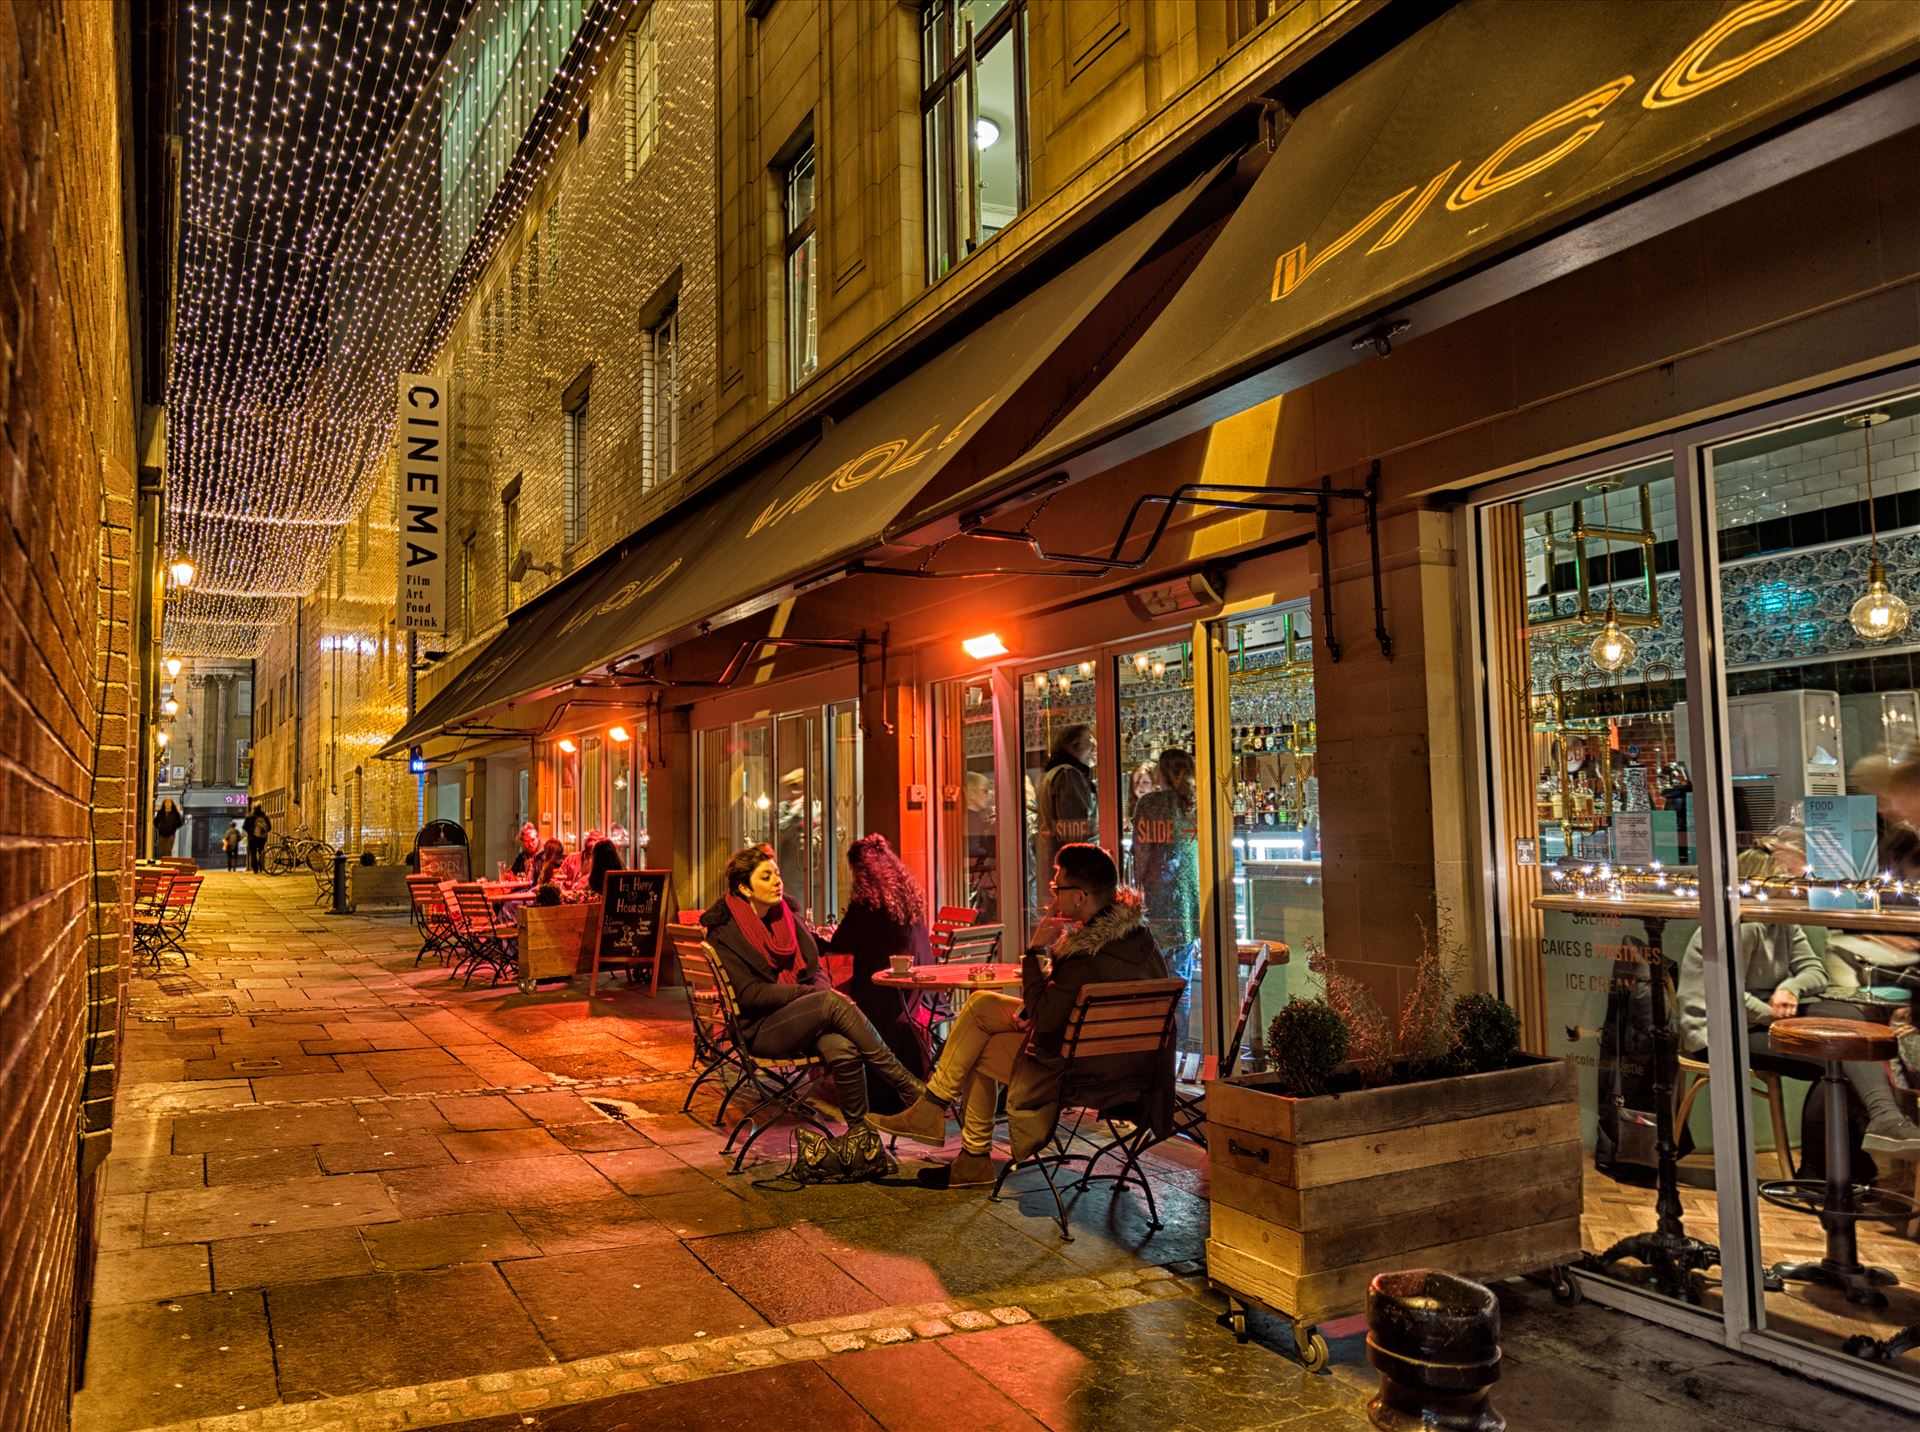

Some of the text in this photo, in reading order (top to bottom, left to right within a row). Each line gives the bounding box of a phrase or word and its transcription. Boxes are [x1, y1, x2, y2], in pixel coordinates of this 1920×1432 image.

[407, 386, 439, 568] CINEMA
[406, 574, 430, 586] Film
[406, 588, 424, 599] Art
[406, 602, 431, 613] Food
[406, 615, 438, 627] Drink
[1810, 801, 1834, 811] FOOD
[1056, 821, 1088, 842] SLIDE
[1137, 819, 1175, 844] SLIDE
[429, 861, 460, 873] OPEN
[1541, 938, 1661, 965] CAKES & PASTRIES
[1566, 973, 1638, 993] ICE CREAM
